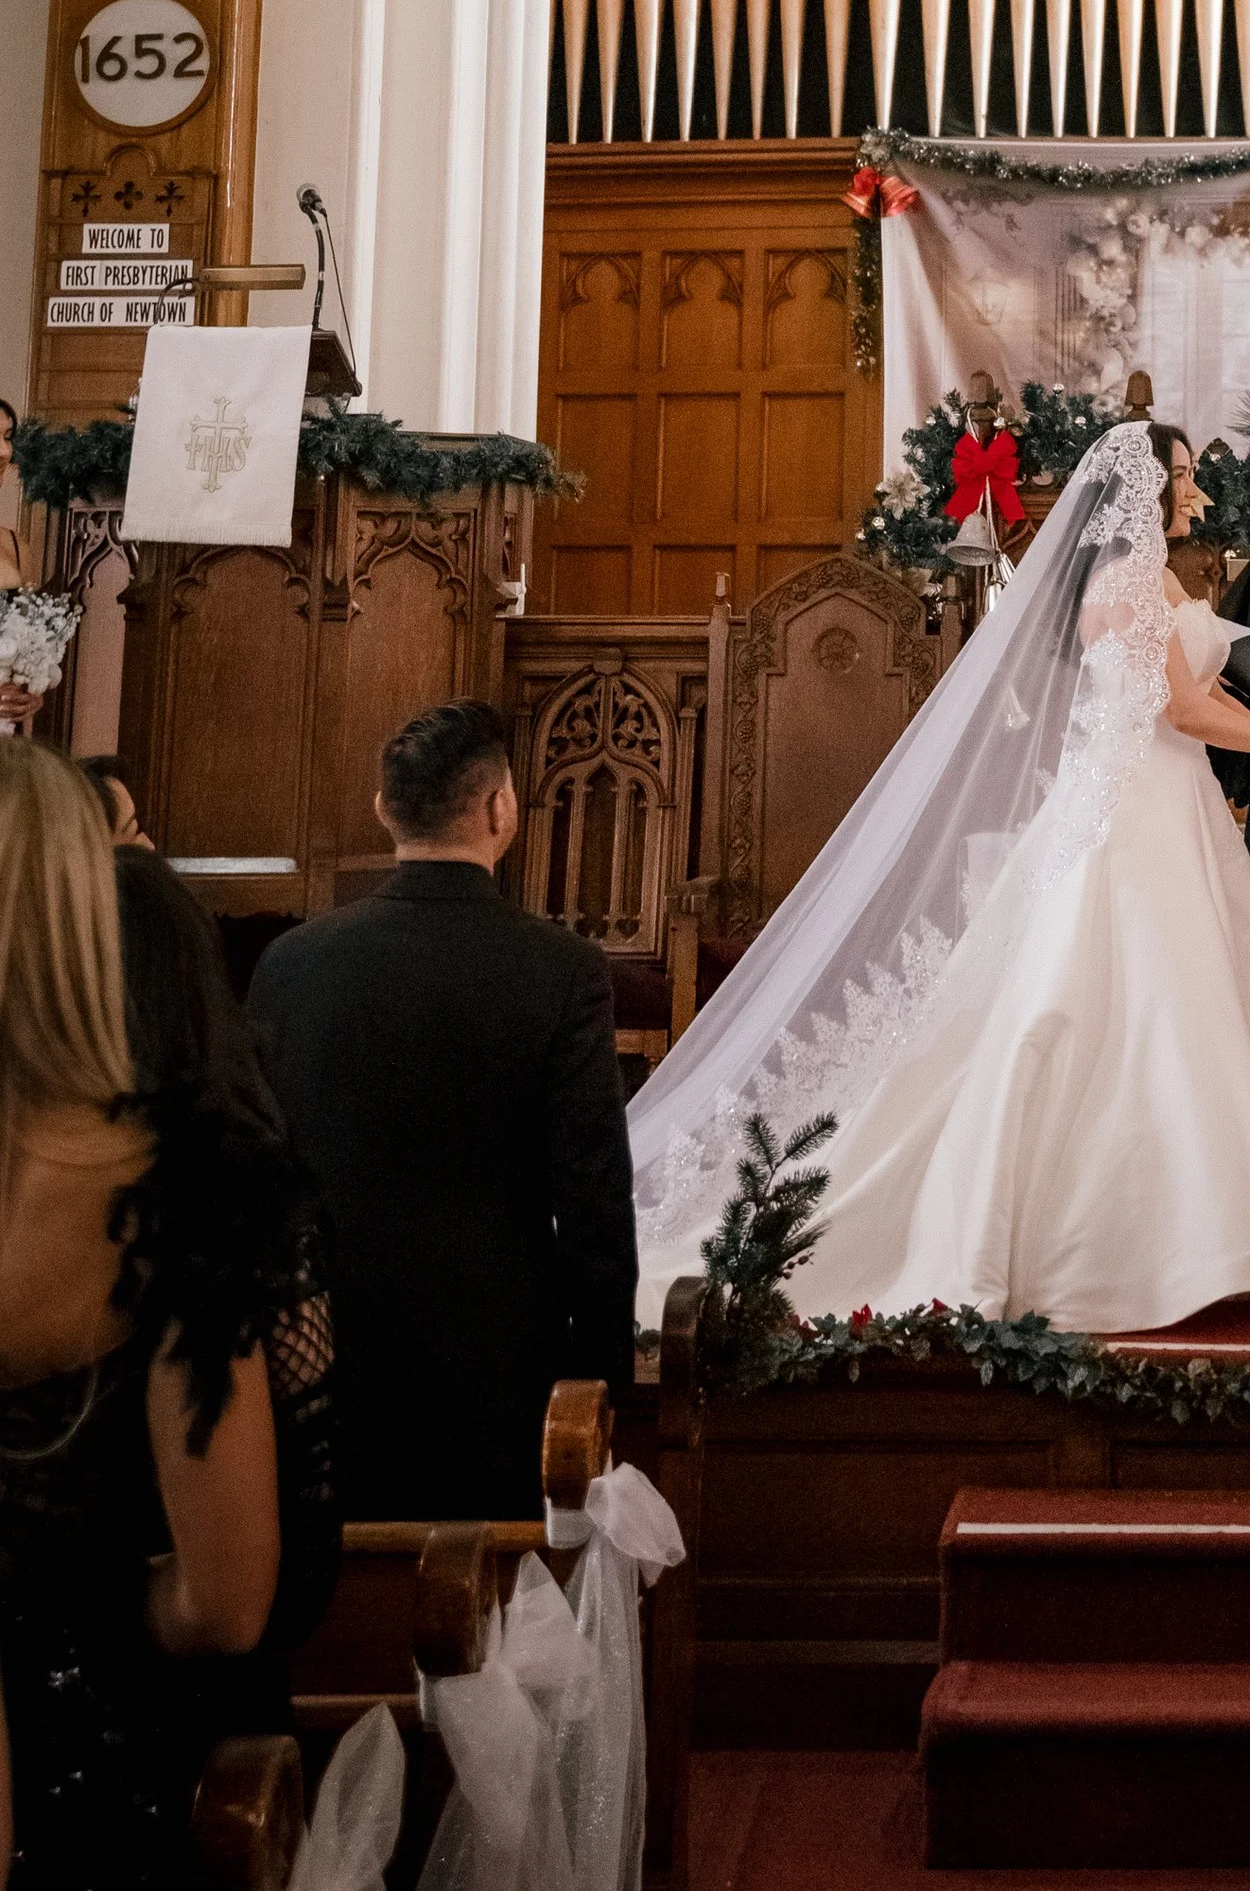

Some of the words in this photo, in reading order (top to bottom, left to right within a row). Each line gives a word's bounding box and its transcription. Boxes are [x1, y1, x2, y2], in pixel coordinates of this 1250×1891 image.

[79, 32, 205, 85] 1652
[88, 228, 142, 249] WELCOME
[150, 228, 164, 249] TO
[65, 265, 96, 286] FIRST
[104, 264, 188, 286] PRESBYTERIAN
[50, 302, 95, 323] CHURCH
[100, 302, 114, 323] OF
[125, 302, 187, 323] NEWTOWN
